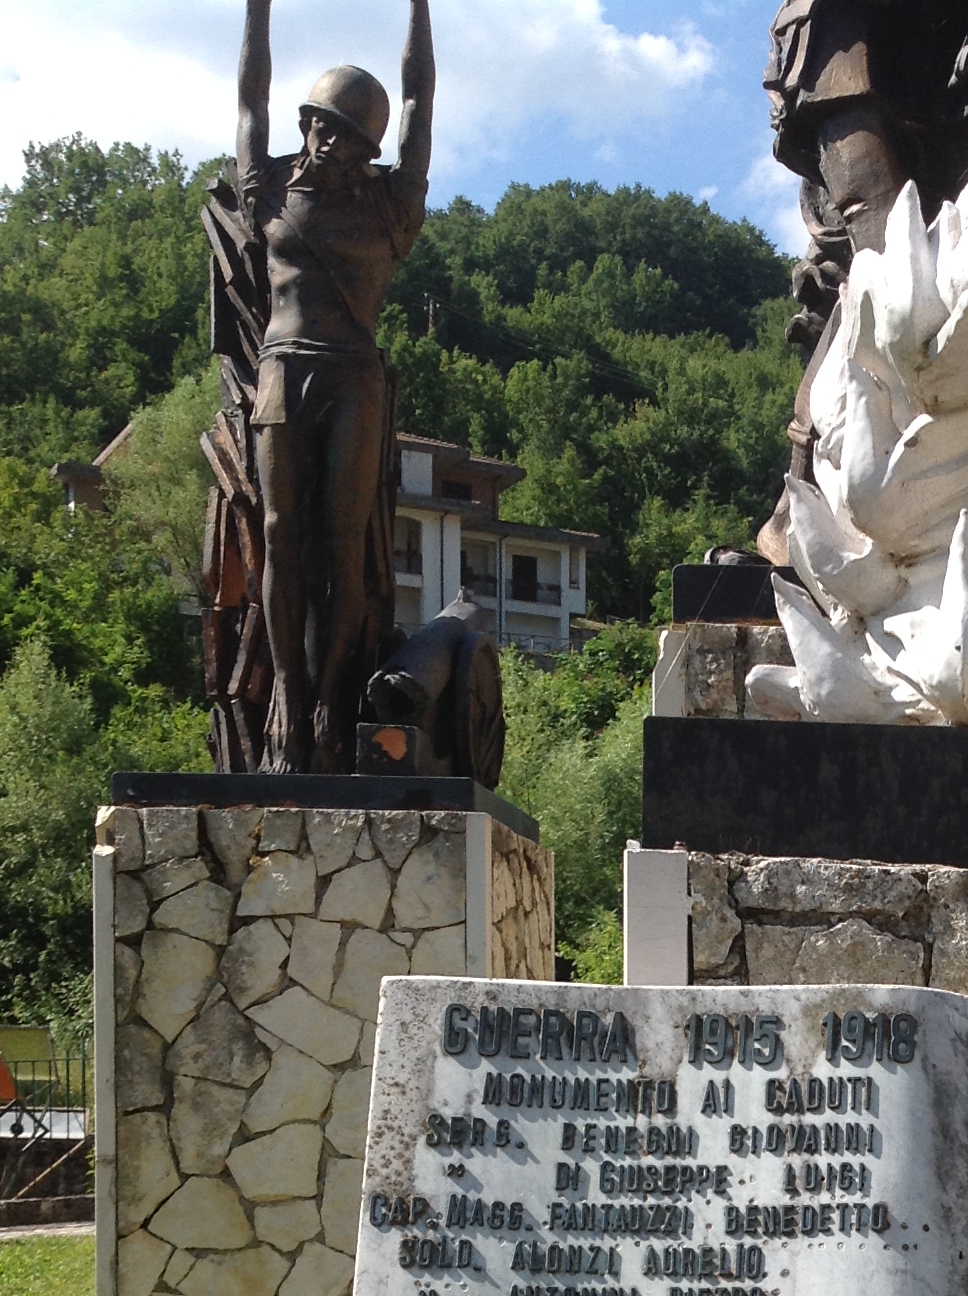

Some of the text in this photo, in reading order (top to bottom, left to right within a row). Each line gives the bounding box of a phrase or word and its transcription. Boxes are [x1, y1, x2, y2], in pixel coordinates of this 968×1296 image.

[444, 1003, 918, 1065] GUERRA 1915 1918
[482, 1072, 873, 1114] MONUMENTO AI CADUTI
[426, 1113, 525, 1149] SERG.
[728, 1123, 875, 1155] GIOVANNI
[555, 1162, 581, 1192] DI
[599, 1160, 729, 1194] GIUSEPPE
[783, 1162, 866, 1192] LUIGI
[548, 1201, 690, 1235] FANTAUZZI
[724, 1203, 888, 1235] BENEDETTO
